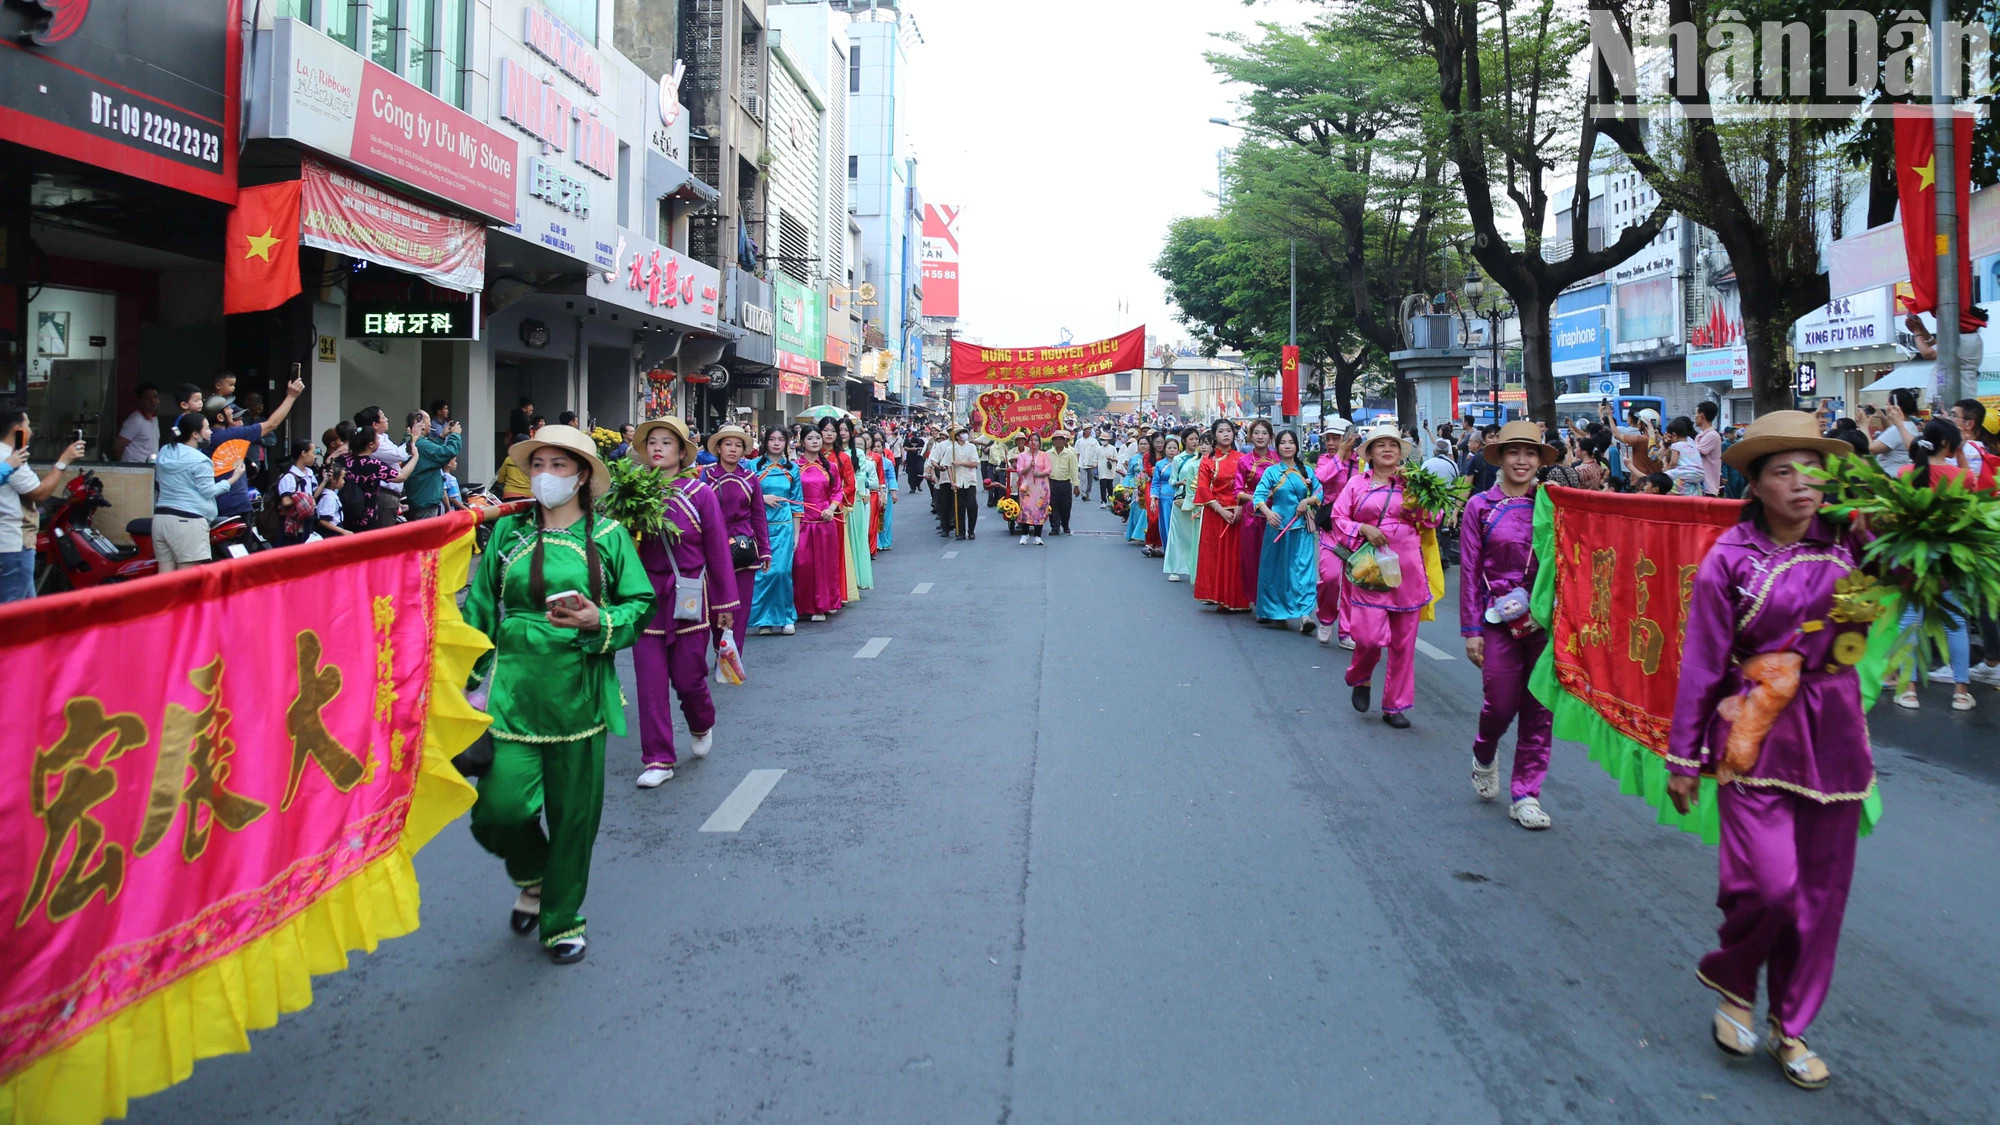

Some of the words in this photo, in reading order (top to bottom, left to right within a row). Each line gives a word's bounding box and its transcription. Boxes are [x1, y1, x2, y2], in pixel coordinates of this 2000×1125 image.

[525, 7, 562, 68] NHA
[561, 35, 602, 97] KHOA
[296, 58, 309, 76] La
[319, 69, 352, 99] Ribbons
[91, 91, 118, 130] ĐT:
[121, 103, 140, 138] 09
[143, 111, 181, 152] 2222
[183, 125, 201, 158] 23
[202, 132, 219, 164] 23
[502, 57, 572, 156] NHẬT
[573, 104, 617, 181] TÂN
[372, 88, 414, 140] Công
[418, 112, 432, 148] ty
[436, 119, 456, 153] Ưu
[459, 131, 478, 169] Mỹ
[480, 143, 512, 180] Store
[932, 270, 943, 279] 55
[944, 270, 956, 280] 88
[364, 311, 453, 334] 日新牙科
[742, 301, 774, 337] CITIZEN
[320, 337, 335, 355] 34
[1556, 326, 1596, 348] vinaphone
[1805, 330, 1829, 345] XING
[1831, 328, 1844, 341] FU
[1846, 324, 1875, 340] TANG
[1733, 366, 1746, 376] PHÁT
